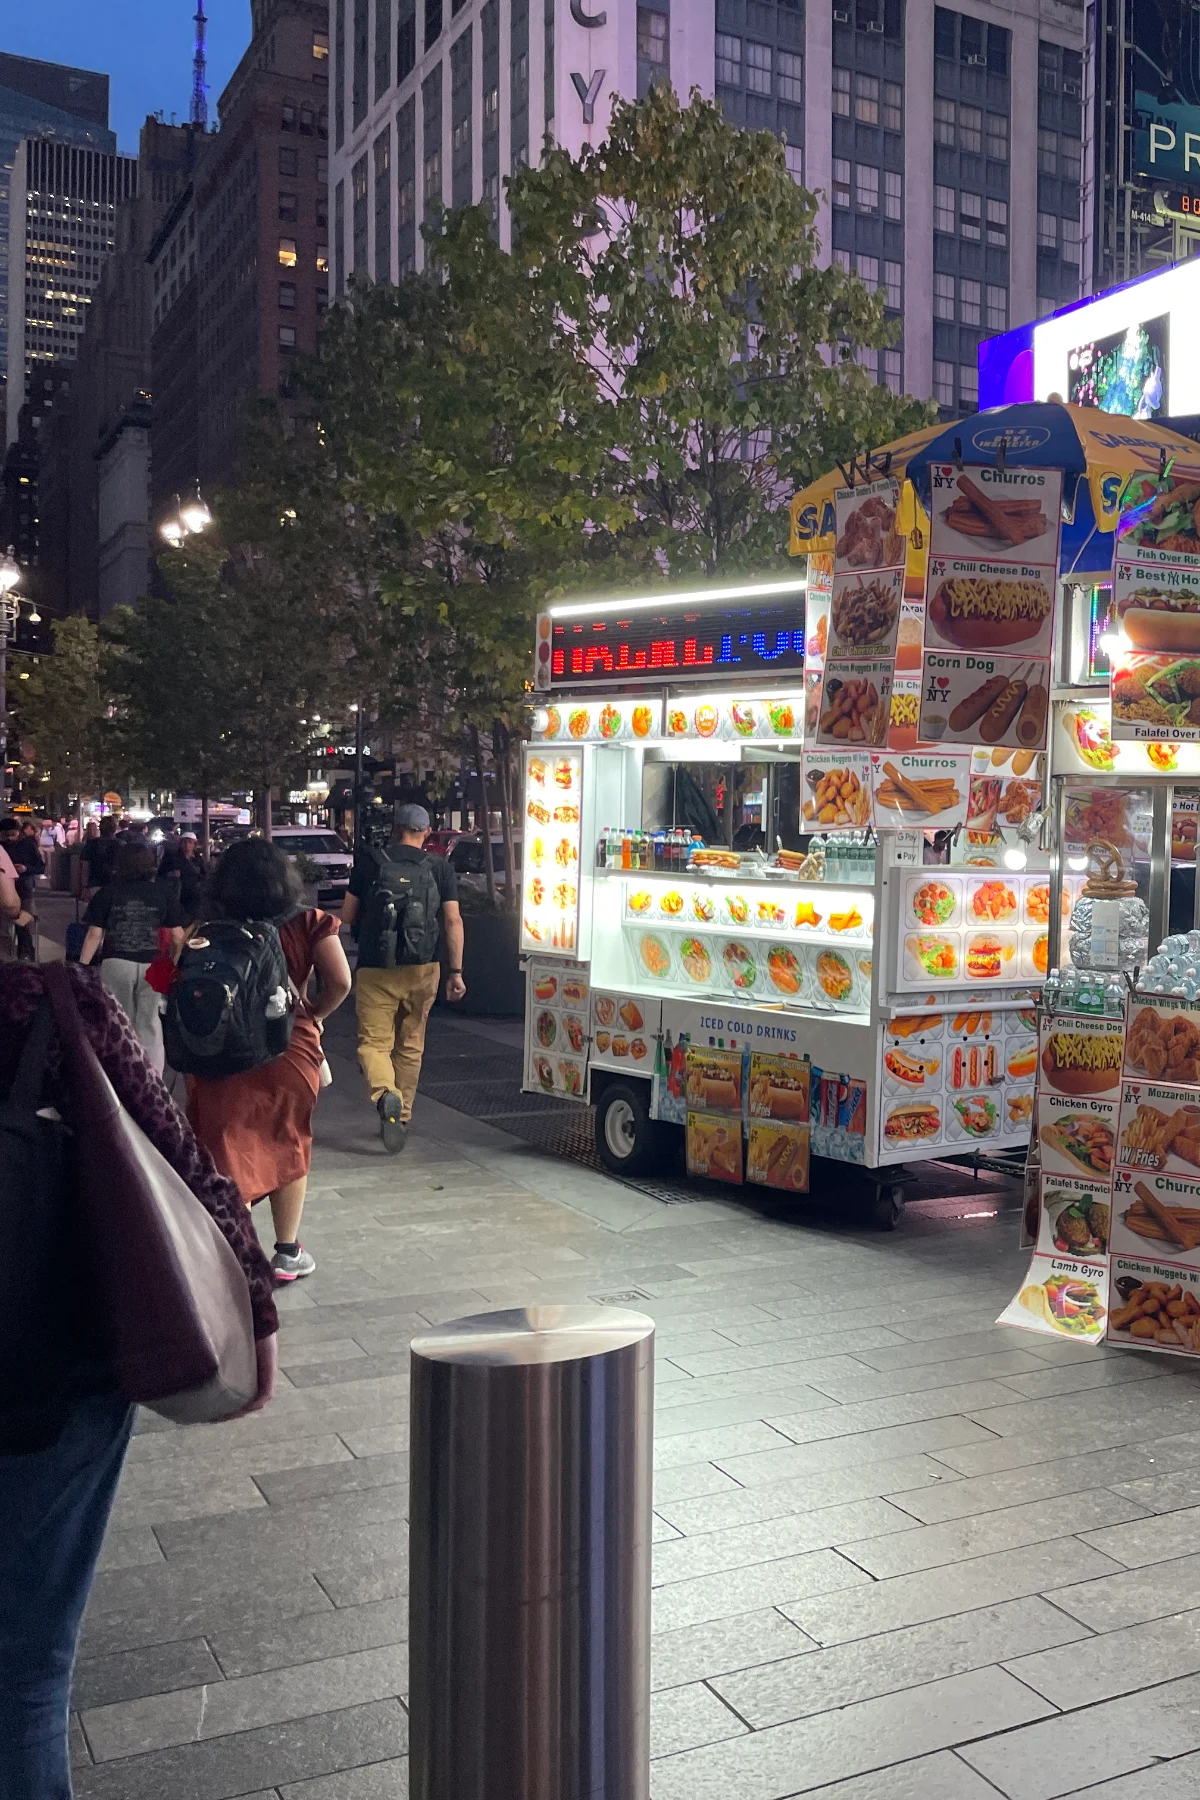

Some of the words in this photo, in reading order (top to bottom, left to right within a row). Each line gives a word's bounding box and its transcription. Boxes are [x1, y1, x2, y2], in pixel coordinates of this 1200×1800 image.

[980, 469, 1045, 486] Churros
[1137, 549, 1156, 561] Fish
[1159, 552, 1181, 563] Over
[953, 562, 983, 573] Chili
[985, 563, 1018, 576] Cheese
[1021, 566, 1041, 579] Dog
[1136, 568, 1166, 583] Best
[927, 655, 960, 669] Corn
[966, 657, 995, 674] Dog
[1135, 727, 1170, 739] Falafel
[1172, 728, 1196, 740] Over
[806, 754, 830, 764] Chicken
[831, 755, 852, 765] Nuggets
[901, 756, 957, 769] Churros
[1179, 801, 1194, 811] Hot
[905, 833, 917, 845] Pay
[903, 852, 917, 863] Pay
[700, 1016, 724, 1030] ICED
[727, 1020, 752, 1034] COLD
[756, 1025, 797, 1042] DRINKS
[1057, 1018, 1073, 1029] Chili
[1075, 1020, 1104, 1031] Cheese
[1106, 1022, 1123, 1033] Dog
[1148, 1087, 1195, 1103] Mozzarella
[1050, 1097, 1087, 1111] Chicken
[1090, 1100, 1113, 1114] Gyro
[1134, 1149, 1160, 1168] Fries
[1046, 1176, 1072, 1190] Falafel
[1051, 1259, 1078, 1273] Lamb
[1080, 1263, 1104, 1278] Gyro
[1117, 1259, 1151, 1273] Chicken
[1153, 1264, 1188, 1282] Nuggets
